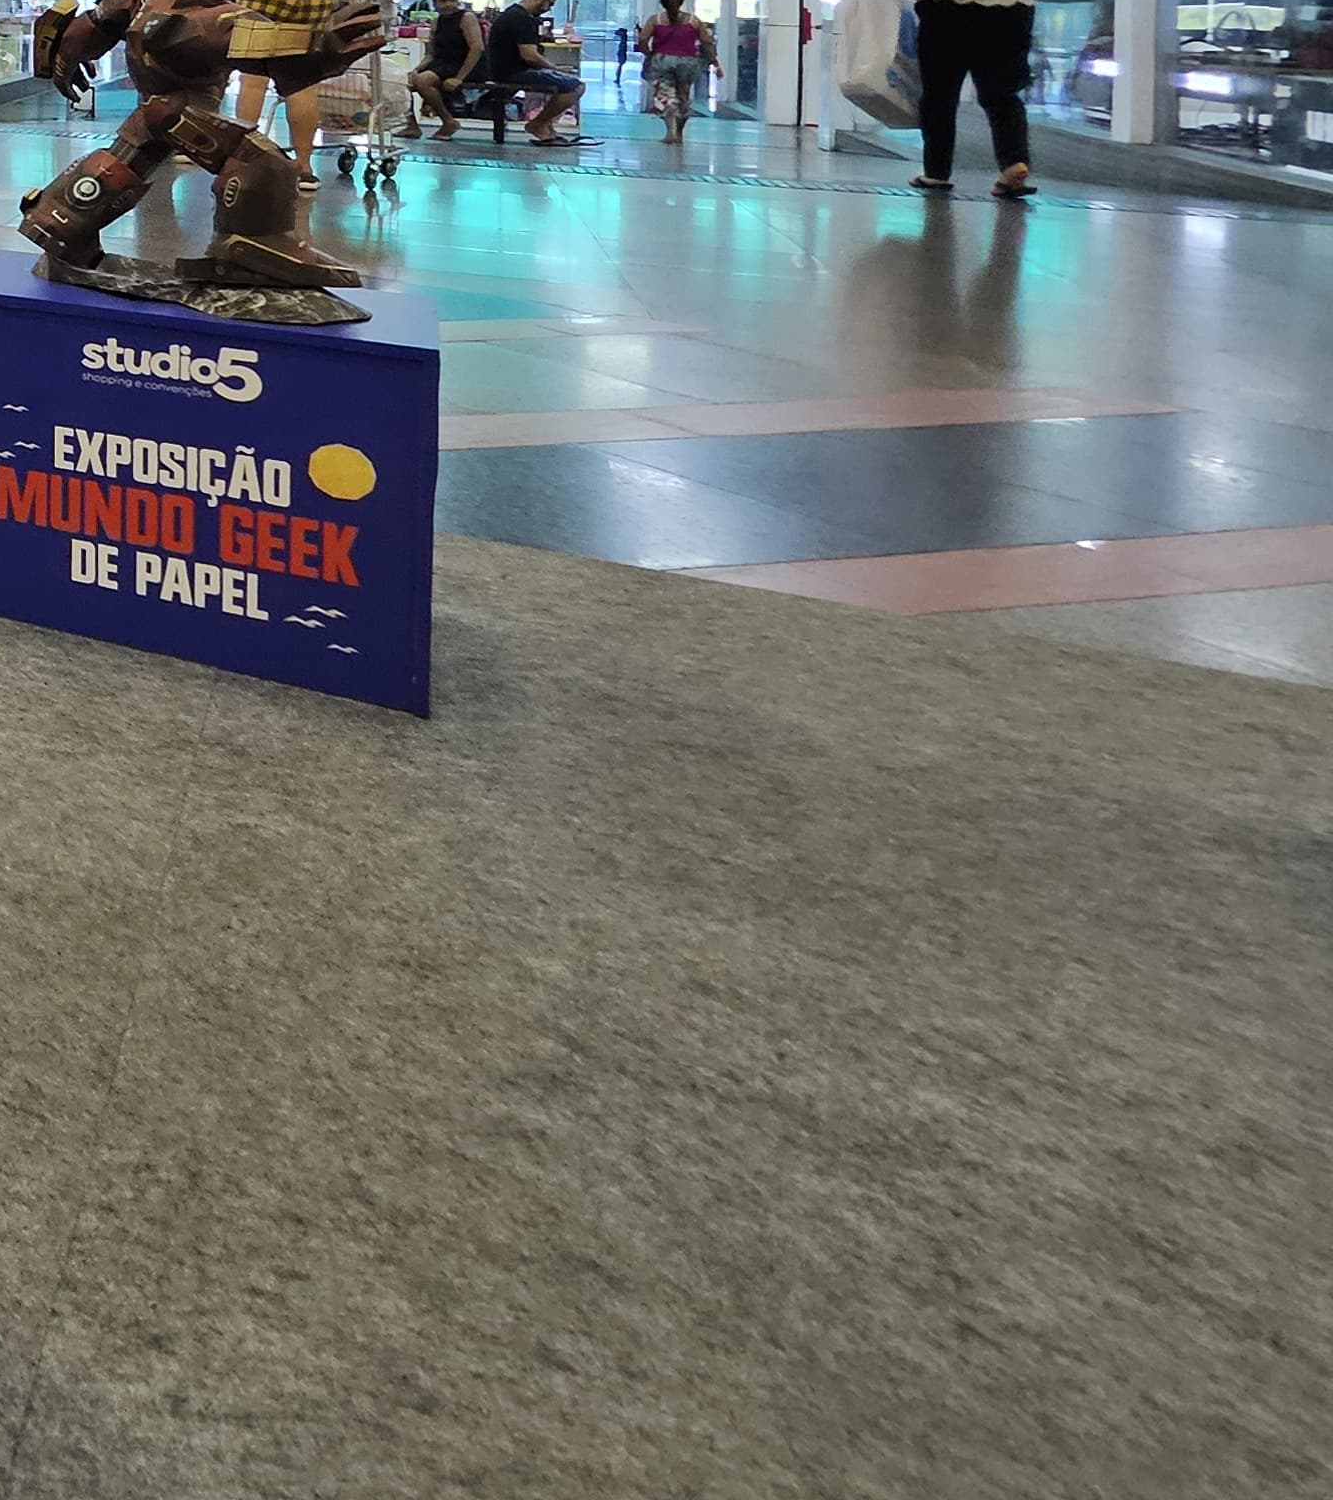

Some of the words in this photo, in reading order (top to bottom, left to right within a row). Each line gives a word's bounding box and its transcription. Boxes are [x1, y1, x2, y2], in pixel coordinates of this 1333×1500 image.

[81, 337, 263, 402] studio5
[82, 372, 133, 389] shopping
[135, 380, 142, 388] e
[144, 381, 213, 398] convenções
[54, 425, 292, 508] EXPOSIÇÃO
[70, 538, 119, 590] DE
[135, 551, 270, 621] PAPEL
[219, 502, 360, 587] GEEK
